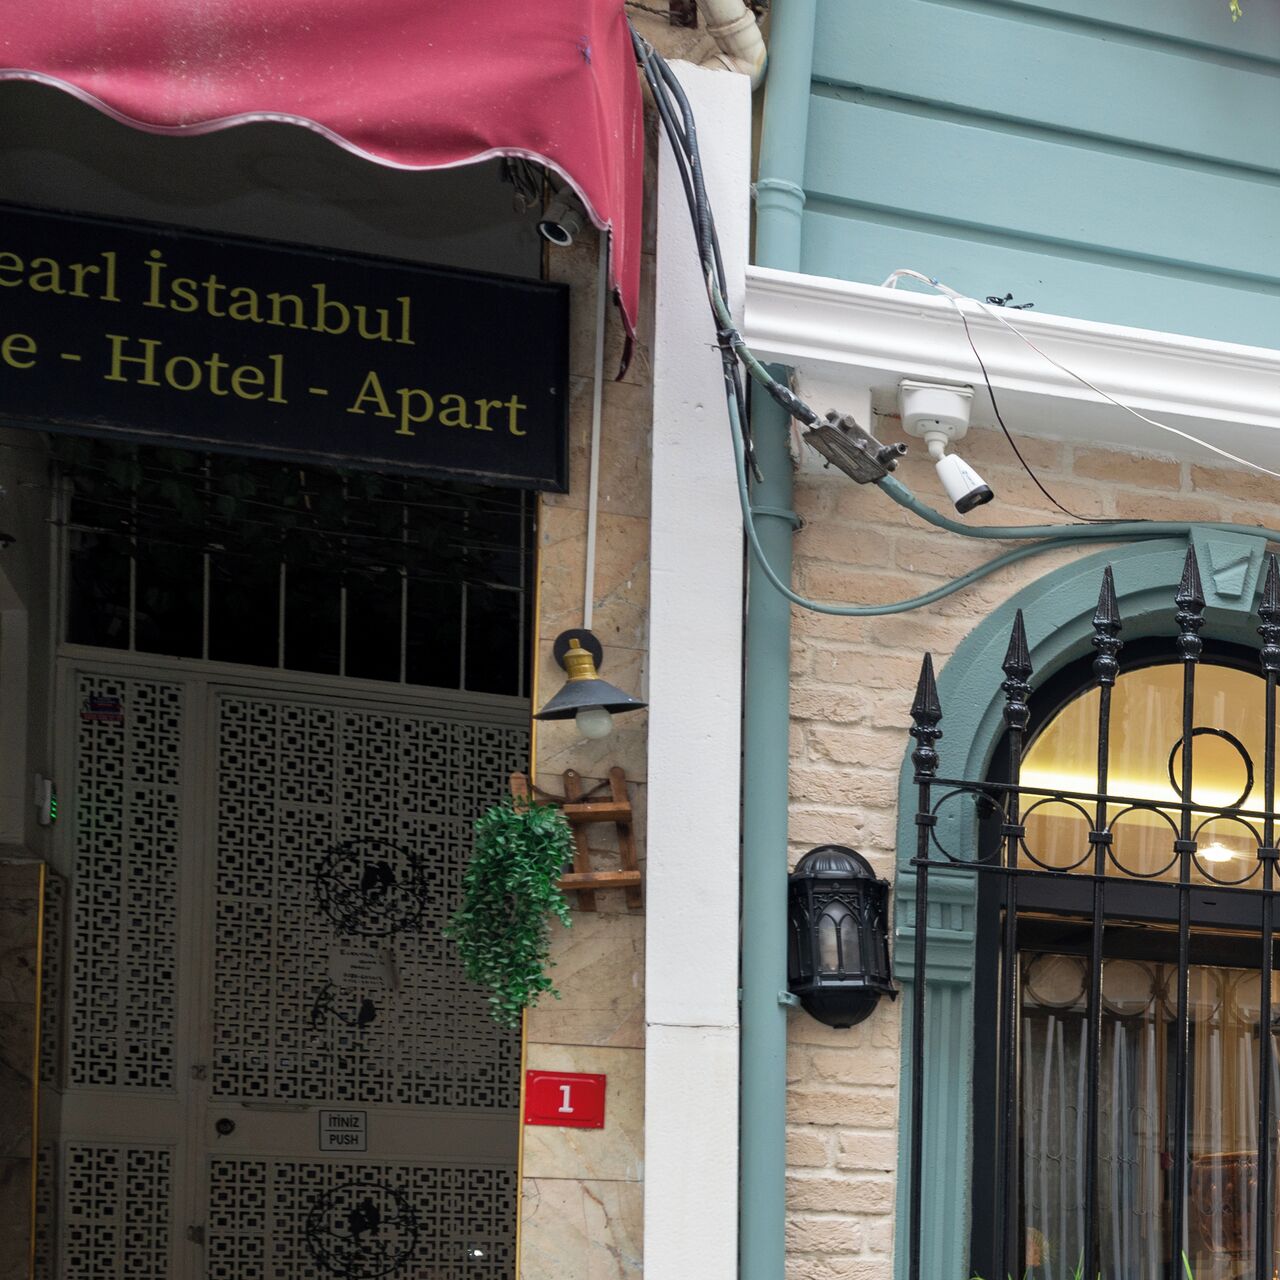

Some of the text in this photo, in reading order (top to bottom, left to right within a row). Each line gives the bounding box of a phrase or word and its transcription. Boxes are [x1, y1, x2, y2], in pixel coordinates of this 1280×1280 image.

[142, 249, 416, 346] İstanbul
[103, 333, 288, 405] Hotel
[346, 370, 528, 437] Apart
[558, 1084, 574, 1114] 1
[329, 1134, 359, 1145] PUSH
